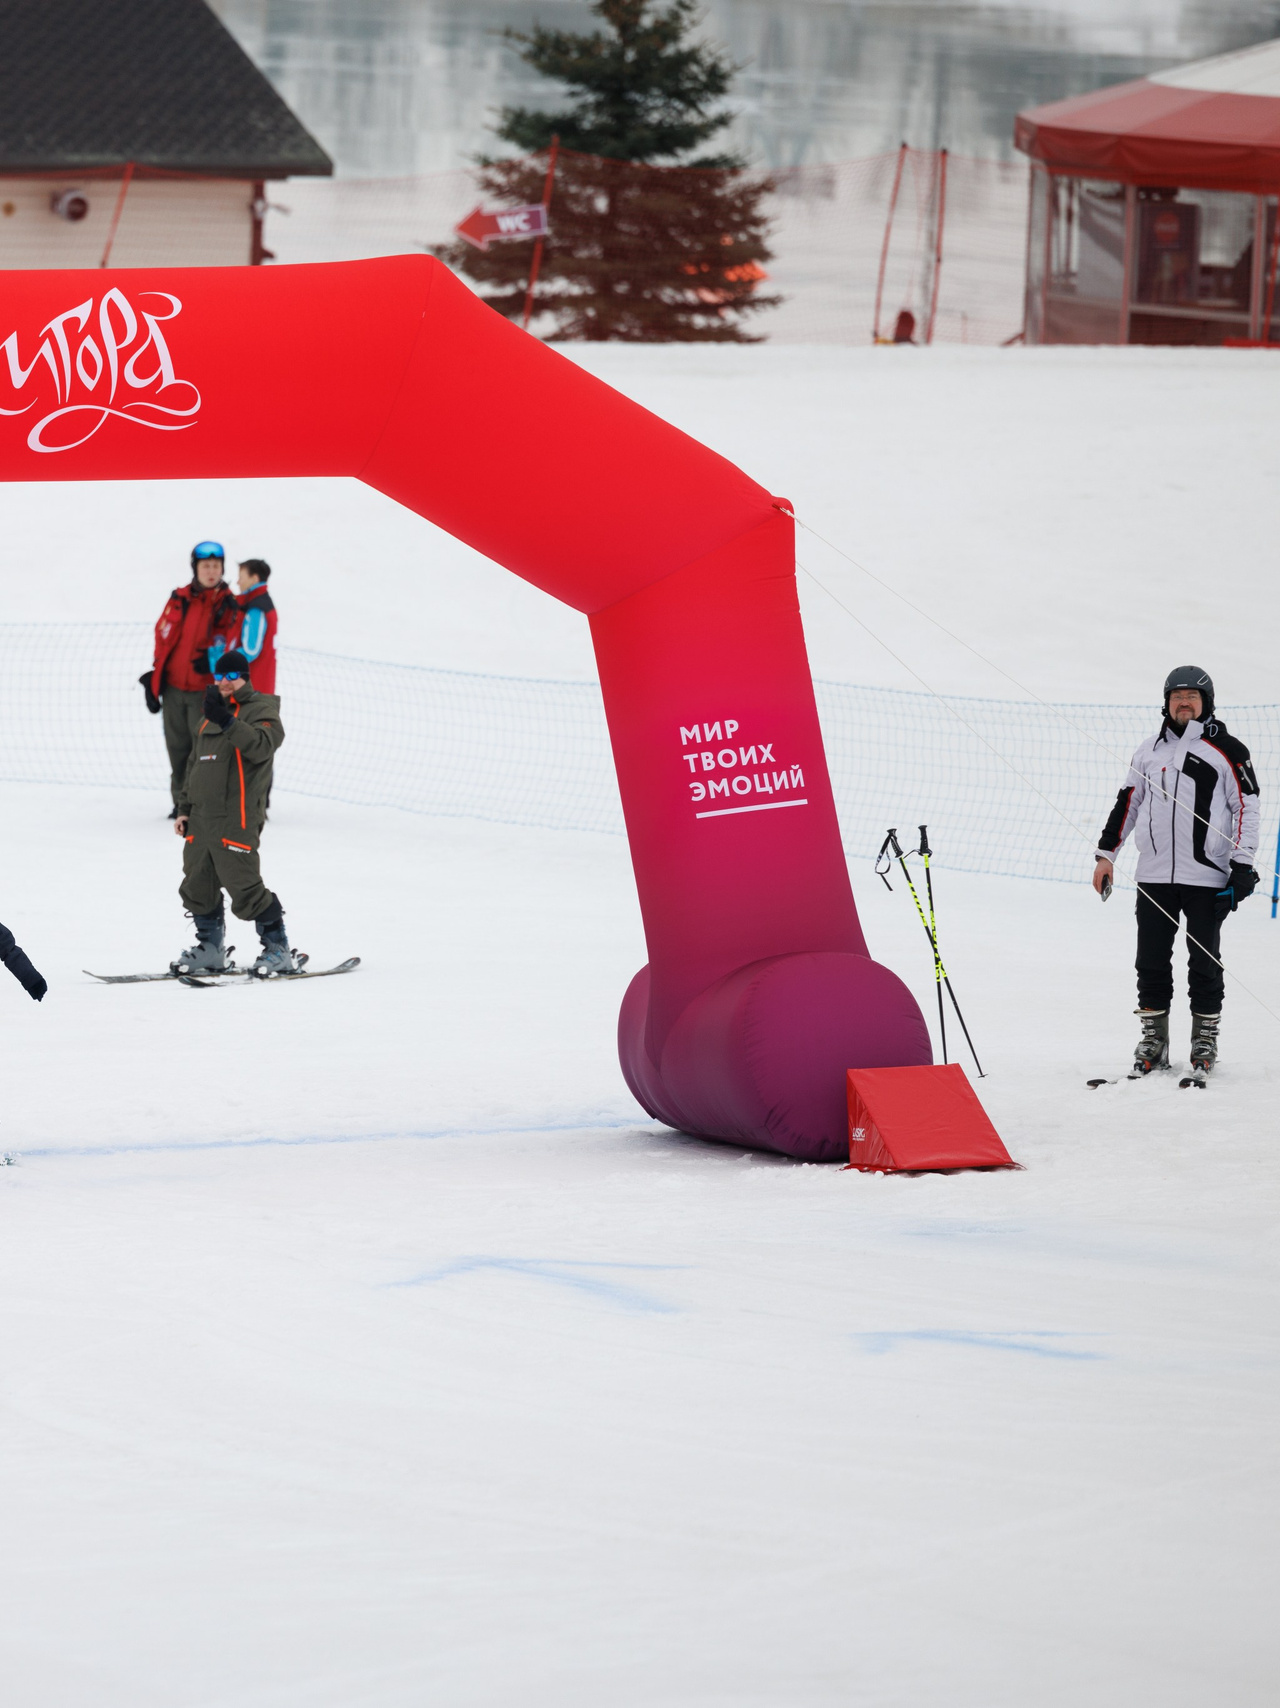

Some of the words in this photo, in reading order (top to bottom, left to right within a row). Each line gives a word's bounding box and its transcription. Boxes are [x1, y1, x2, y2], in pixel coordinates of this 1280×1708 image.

[496, 212, 531, 233] WC
[679, 719, 739, 746] МИР
[683, 743, 776, 773] ТВОИХ
[689, 764, 805, 802] ЭМОЦИЙ
